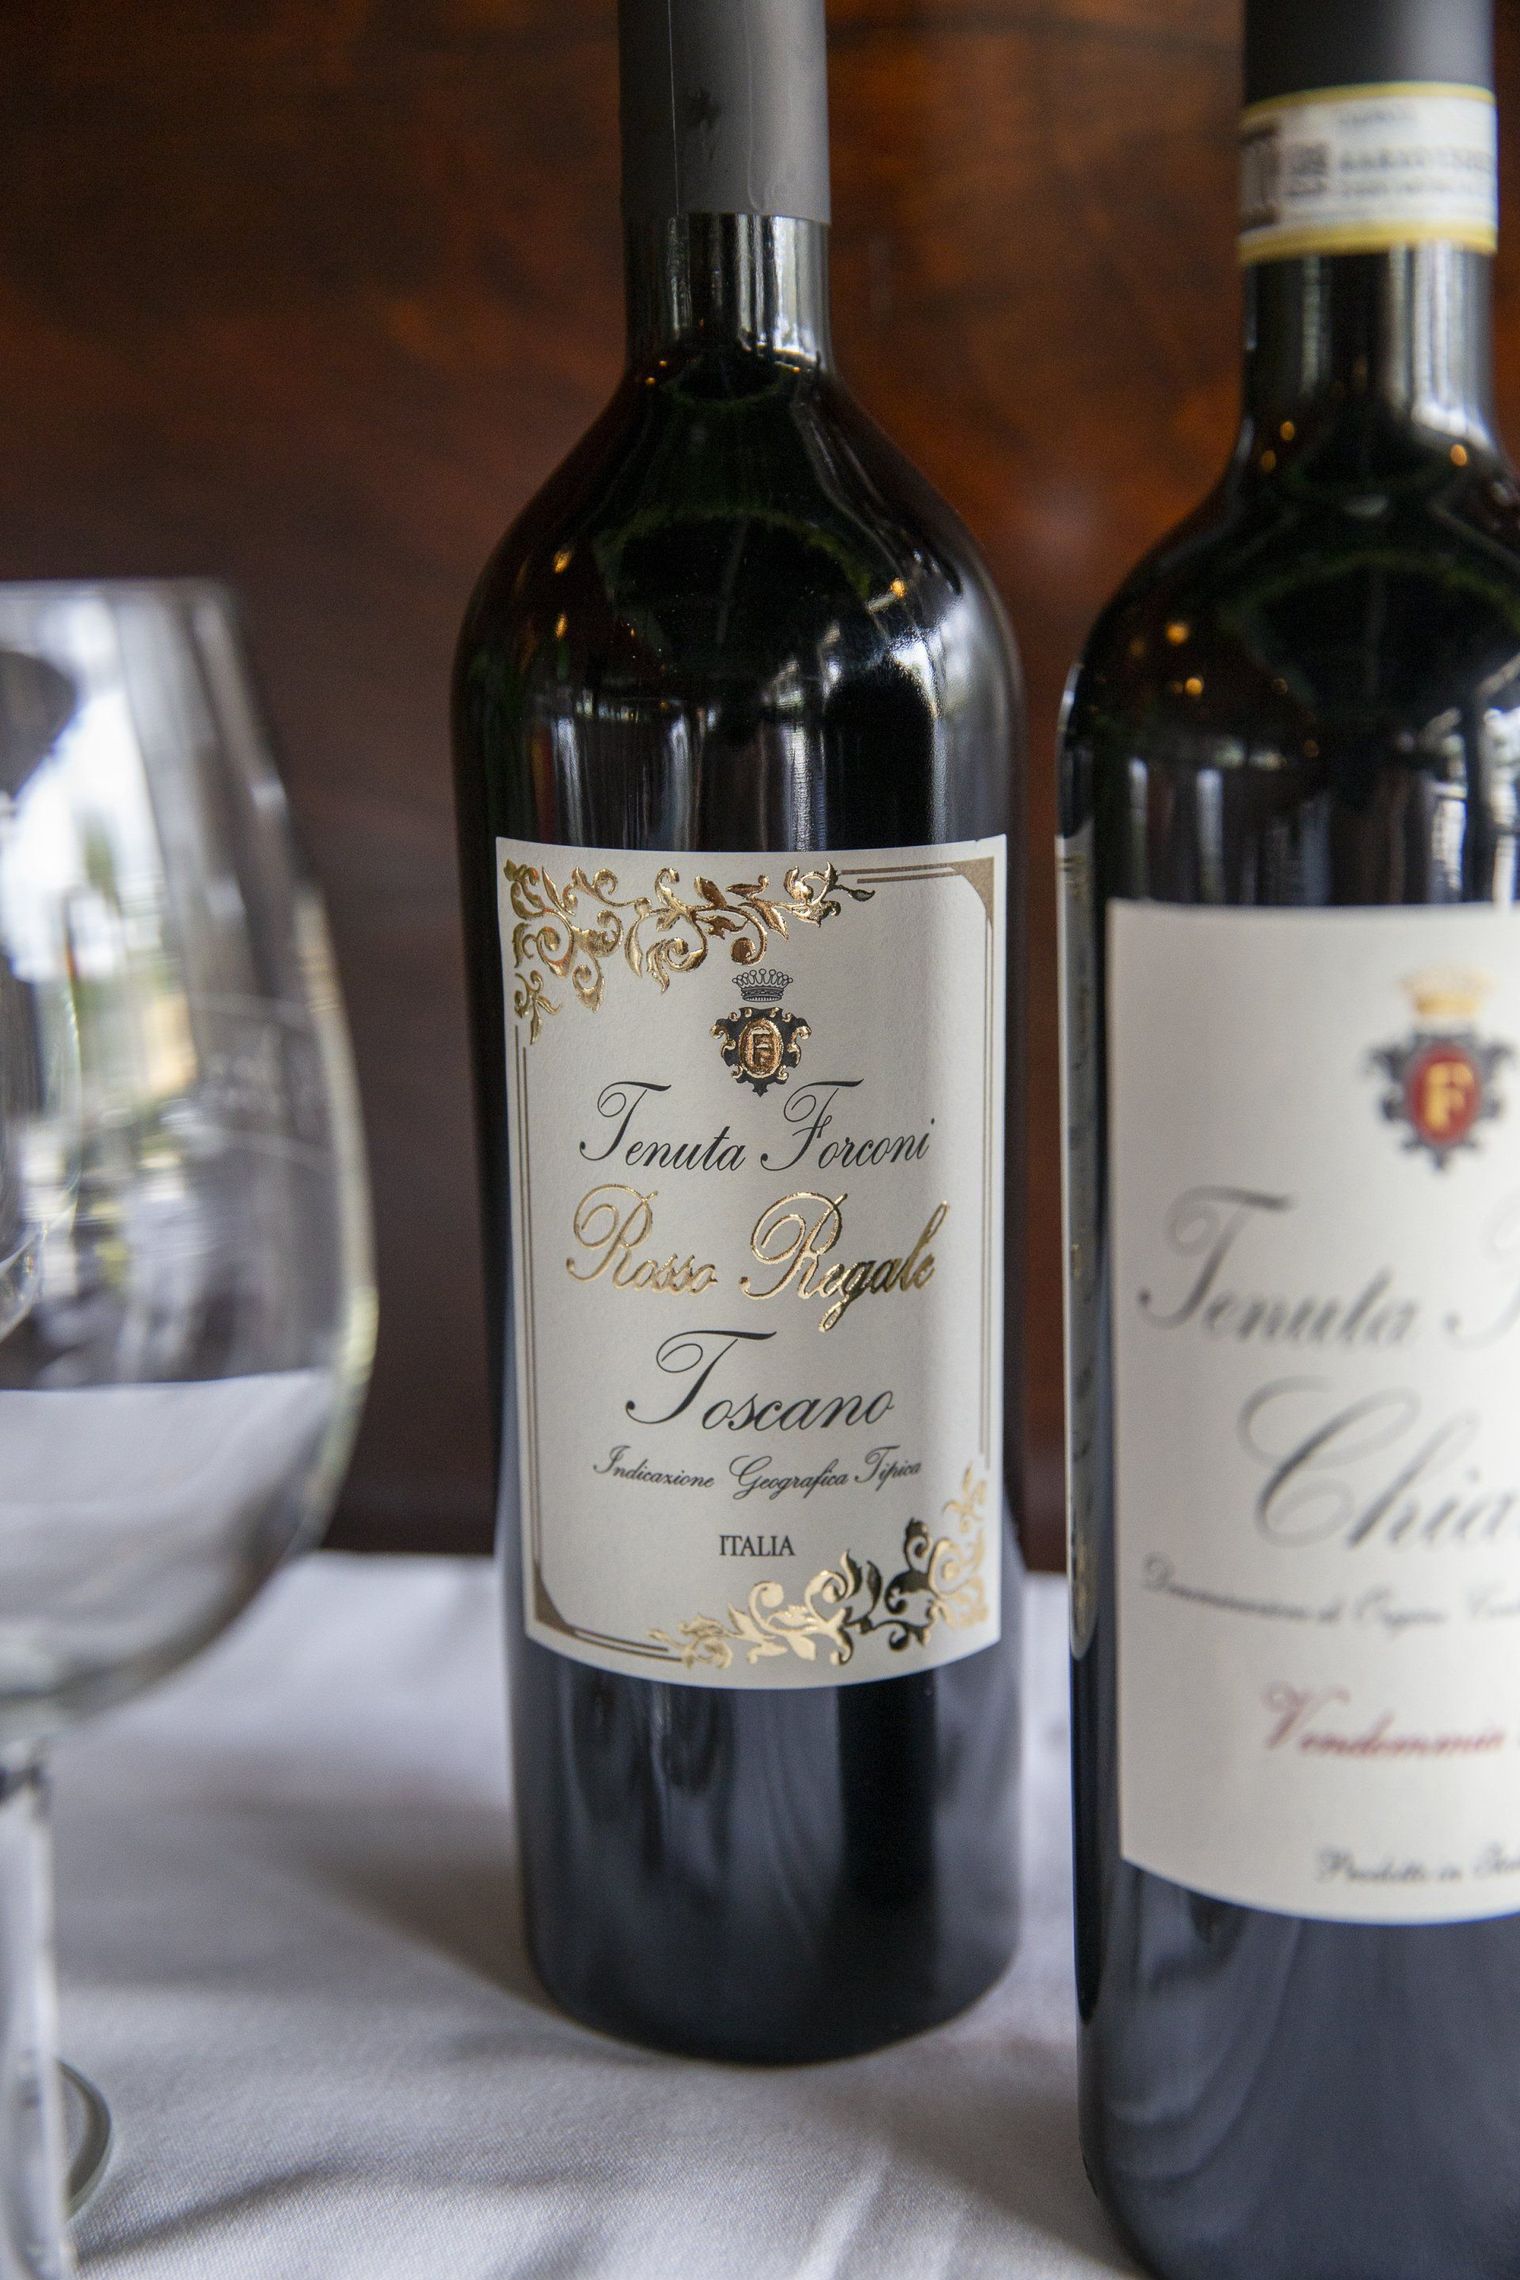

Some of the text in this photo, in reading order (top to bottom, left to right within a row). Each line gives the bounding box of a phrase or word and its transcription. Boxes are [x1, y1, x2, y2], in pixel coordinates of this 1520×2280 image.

[579, 1078, 936, 1171] Tenuta Forconi
[565, 1183, 950, 1332] Rosso Regale
[1139, 1185, 1421, 1342] Tenuta
[626, 1330, 895, 1431] Toscano
[593, 1445, 922, 1500] Indicazione Geografica Tipica
[719, 1534, 796, 1557] ITALIA
